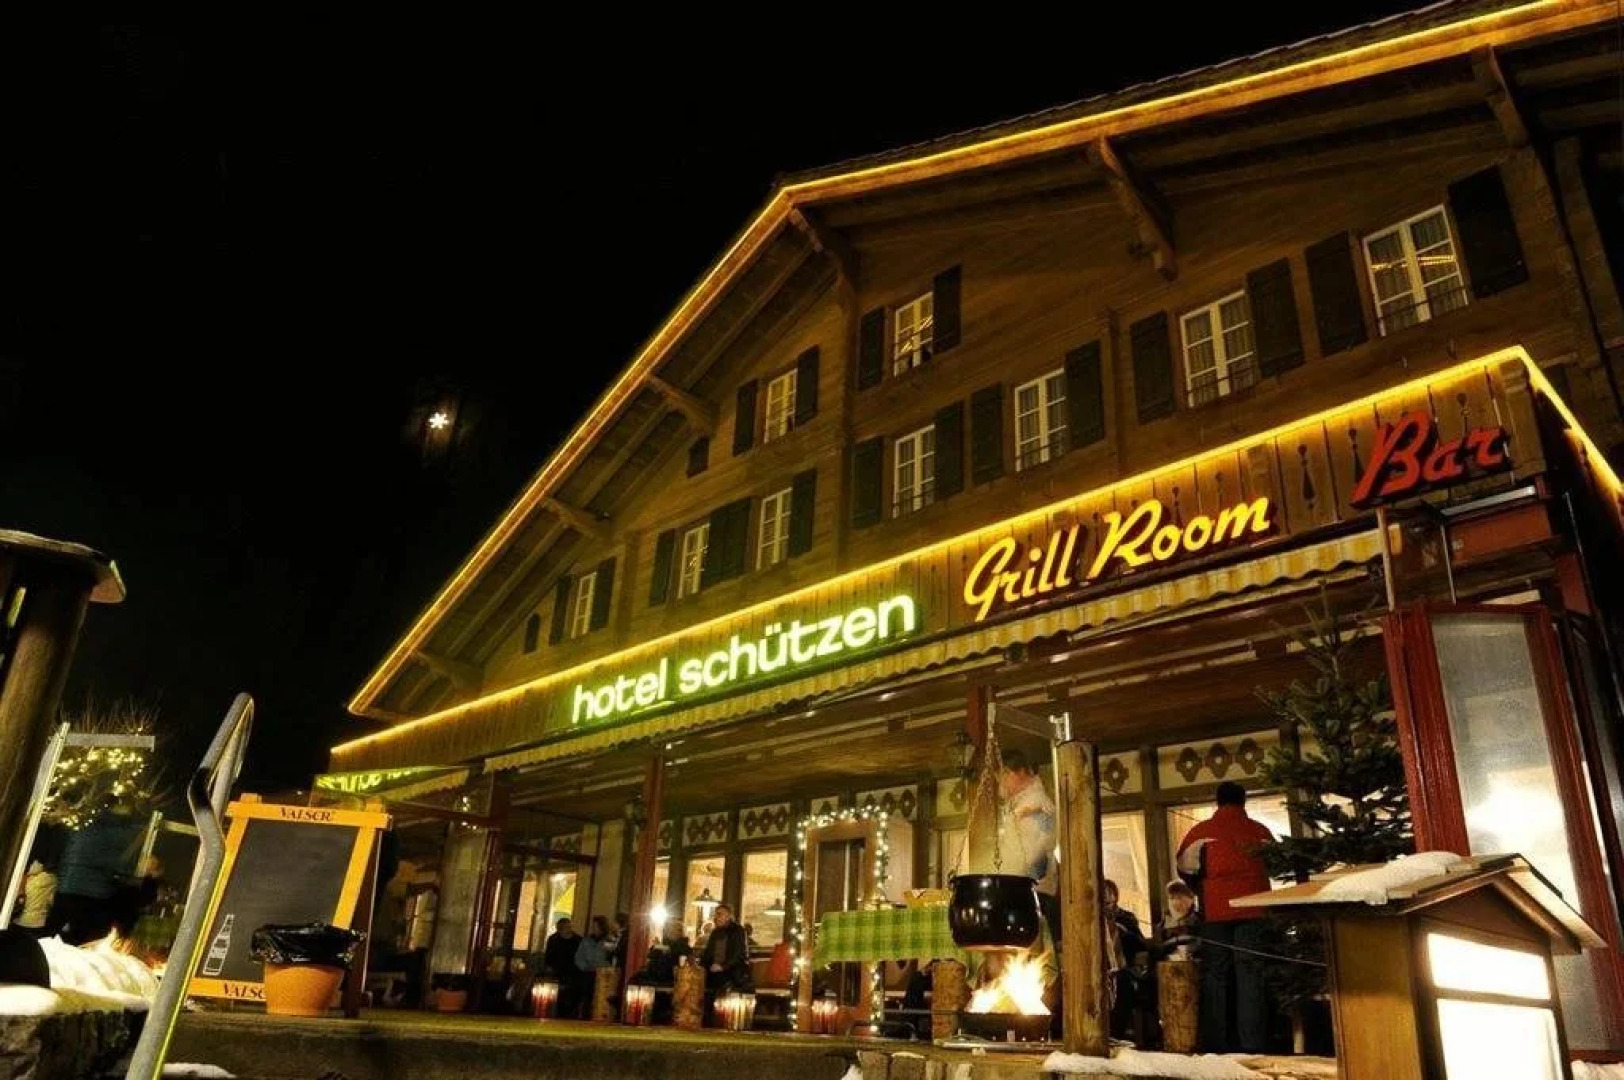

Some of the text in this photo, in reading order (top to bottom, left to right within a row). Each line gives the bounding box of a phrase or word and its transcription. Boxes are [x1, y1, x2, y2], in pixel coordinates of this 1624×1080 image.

[1352, 411, 1508, 506] Bar
[963, 497, 1270, 621] Grill Room
[572, 593, 916, 723] hotel schützen
